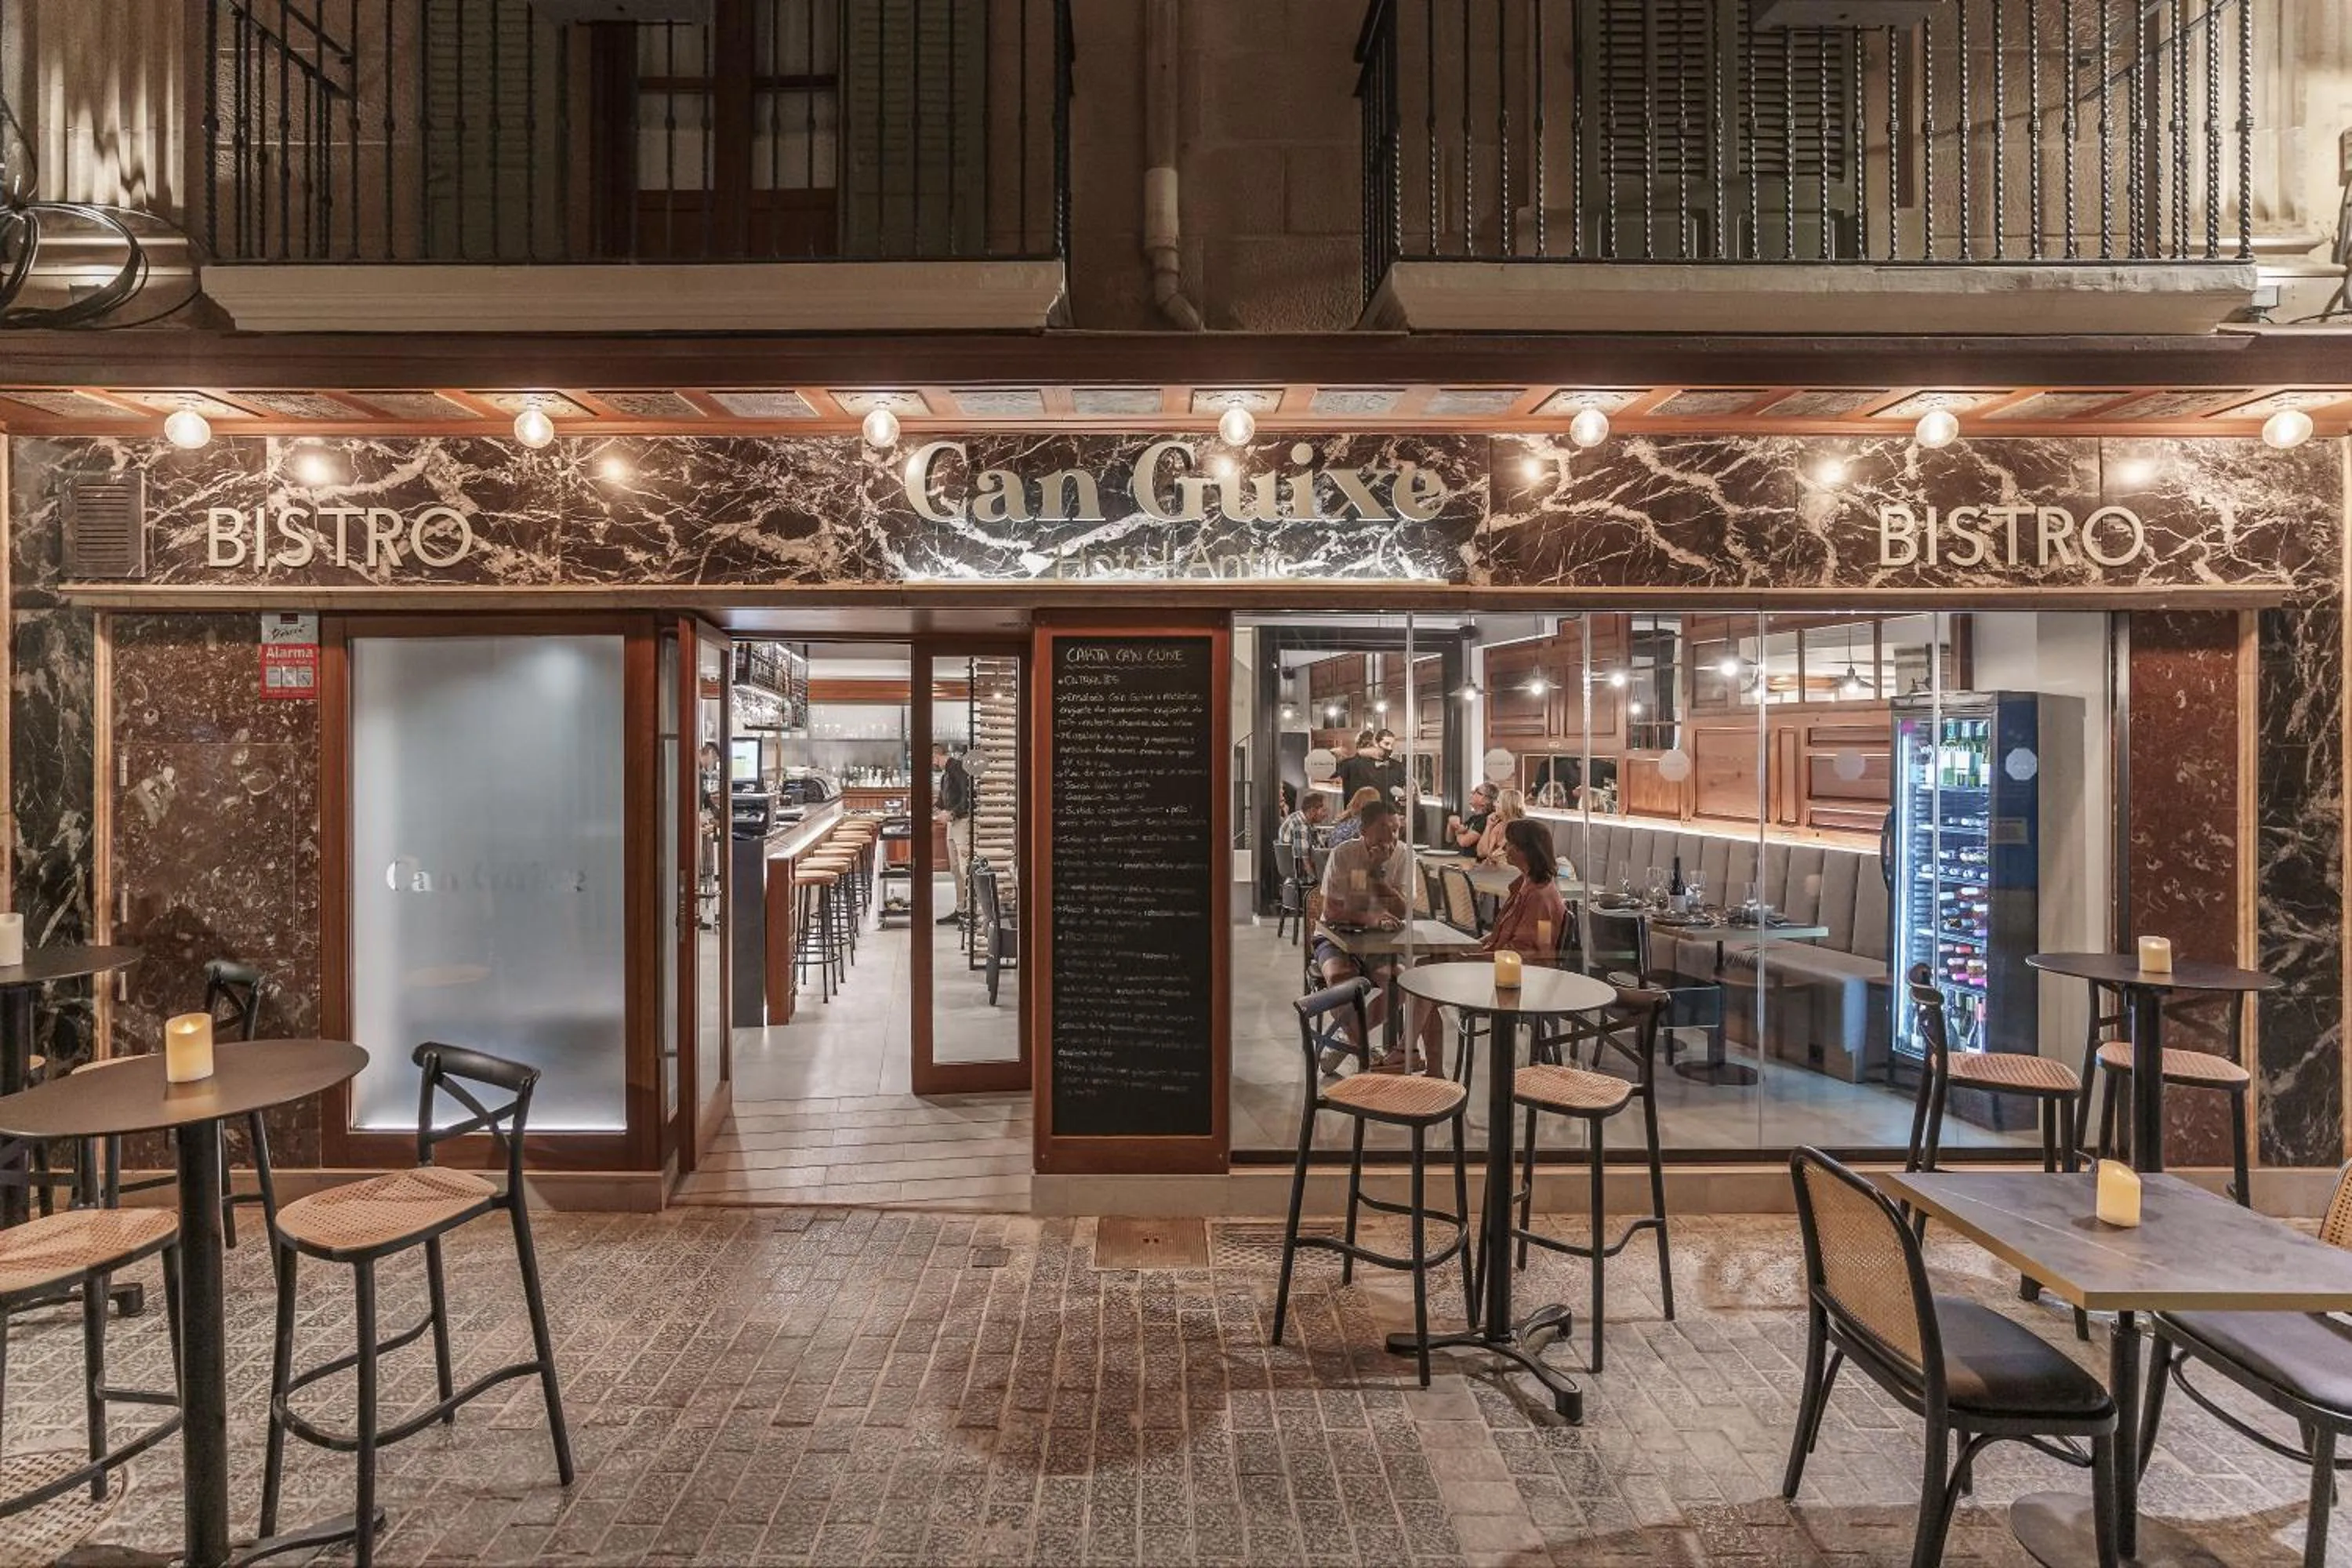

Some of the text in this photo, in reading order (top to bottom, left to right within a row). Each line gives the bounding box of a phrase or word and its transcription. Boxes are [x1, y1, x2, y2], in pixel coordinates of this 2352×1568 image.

[906, 441, 1445, 523] Can Guixe
[208, 506, 472, 568] BISTRO
[1882, 505, 2143, 567] BISTRO
[267, 645, 314, 659] Alarma
